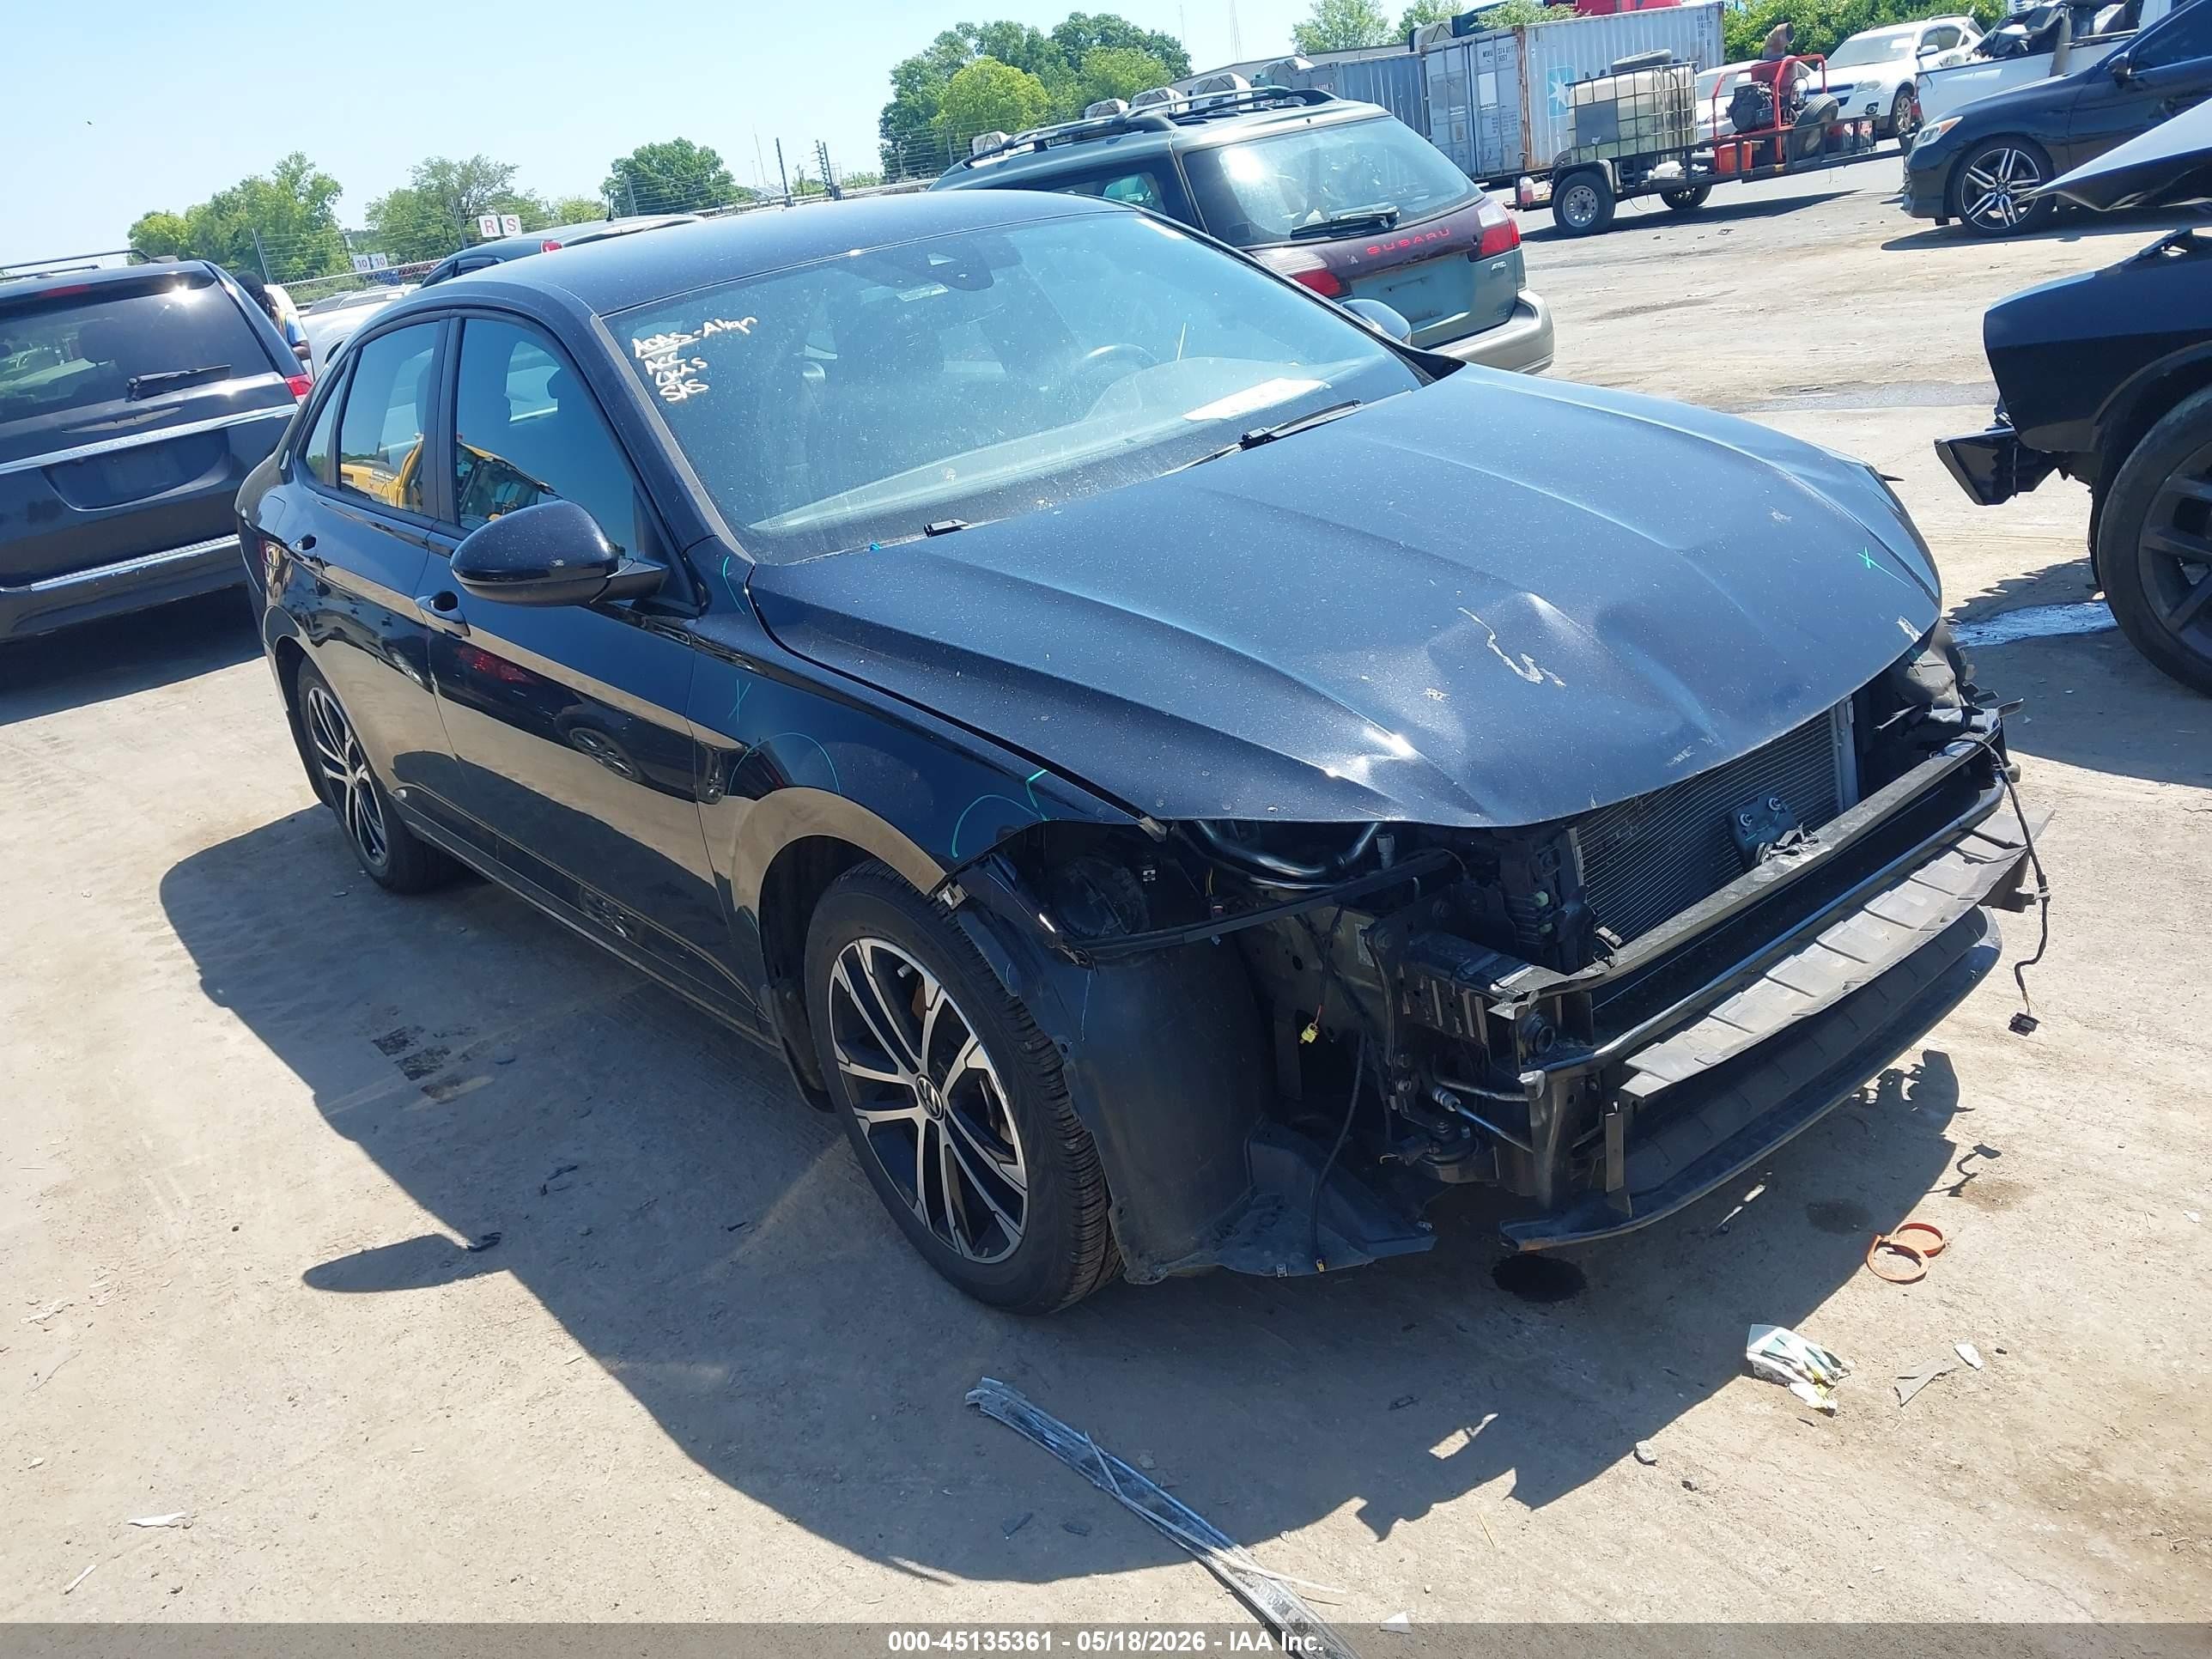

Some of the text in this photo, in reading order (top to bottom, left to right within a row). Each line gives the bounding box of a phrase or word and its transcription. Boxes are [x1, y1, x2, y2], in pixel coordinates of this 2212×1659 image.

[484, 219, 495, 234] R
[507, 218, 517, 232] S
[1366, 228, 1450, 255] SUBARU
[356, 259, 368, 269] 10
[374, 257, 386, 266] 10
